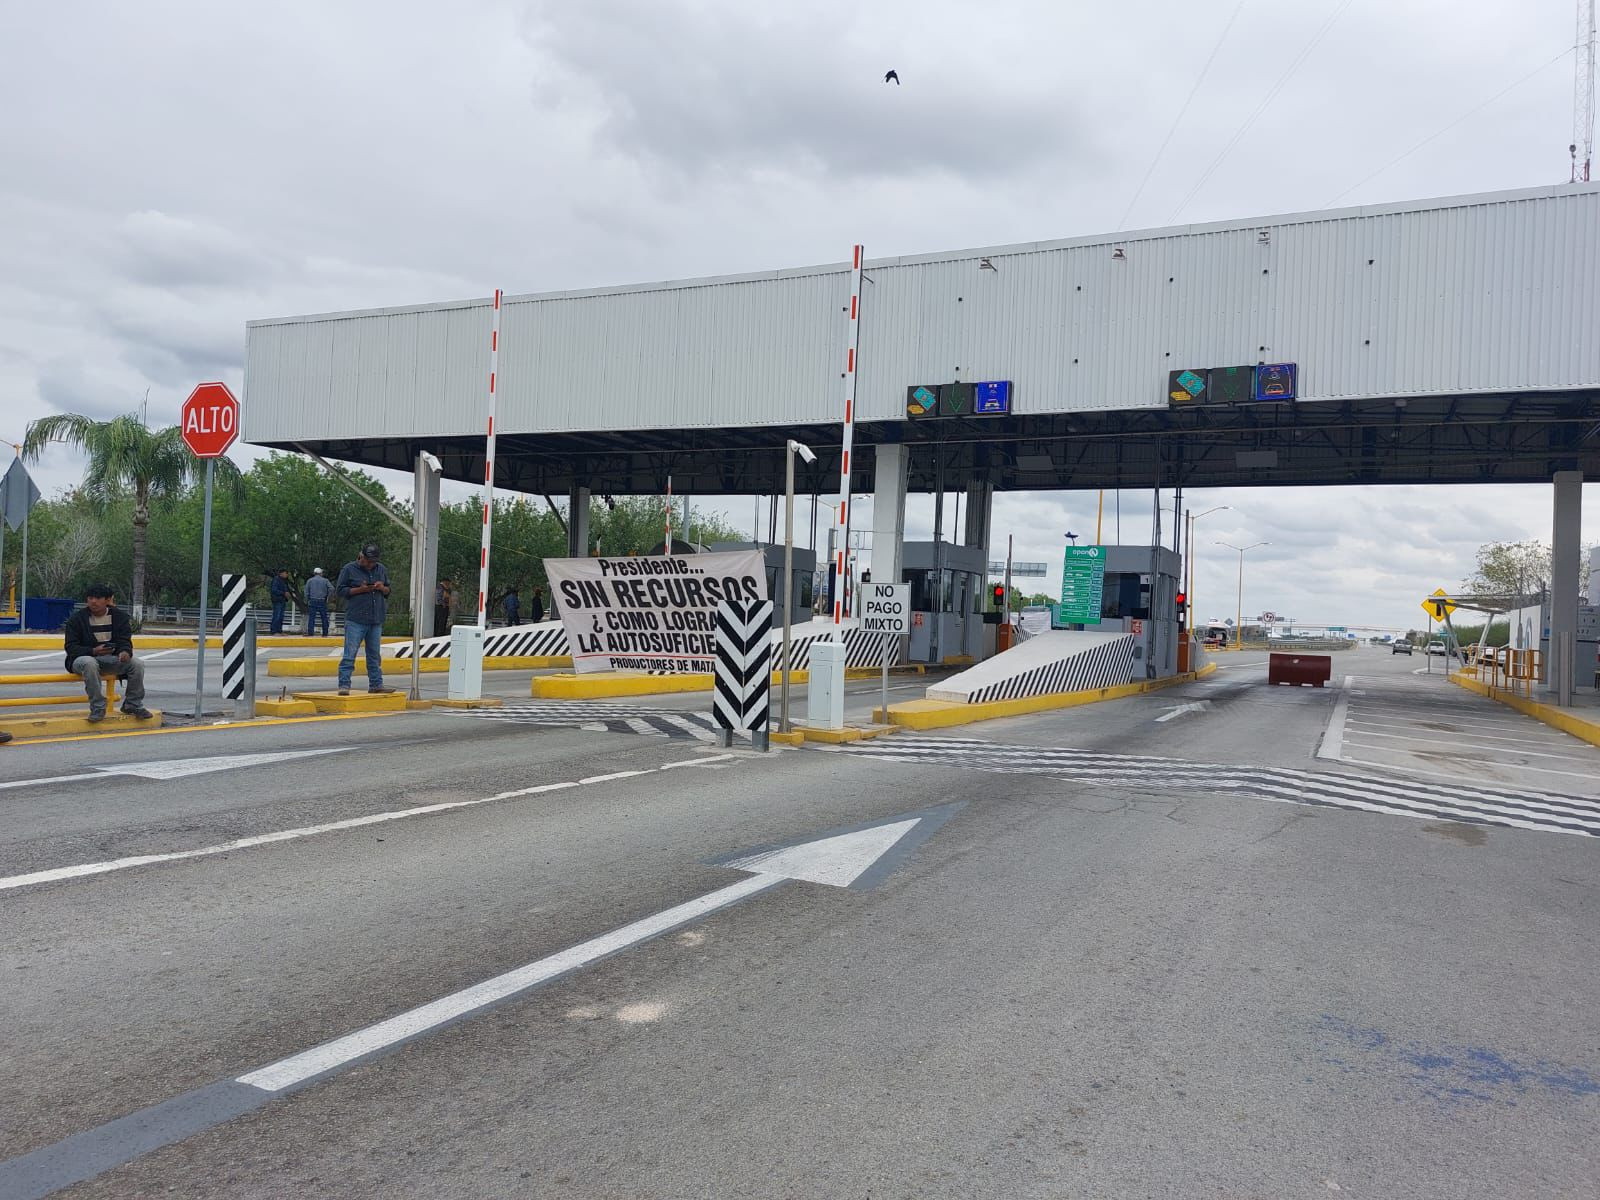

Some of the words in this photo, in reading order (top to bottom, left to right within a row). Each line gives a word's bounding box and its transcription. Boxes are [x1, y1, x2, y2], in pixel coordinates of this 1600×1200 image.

[186, 405, 233, 433] ALTO
[598, 557, 704, 577] Presidente...
[560, 579, 611, 609] SIN
[611, 575, 760, 609] RECURSOS
[875, 585, 894, 598] NO
[867, 601, 902, 614] PAGO
[605, 610, 659, 631] COMO
[864, 618, 903, 631] MIXTO
[577, 633, 603, 653] LA
[610, 657, 674, 671] PRODUCTORES
[676, 659, 689, 671] DE
